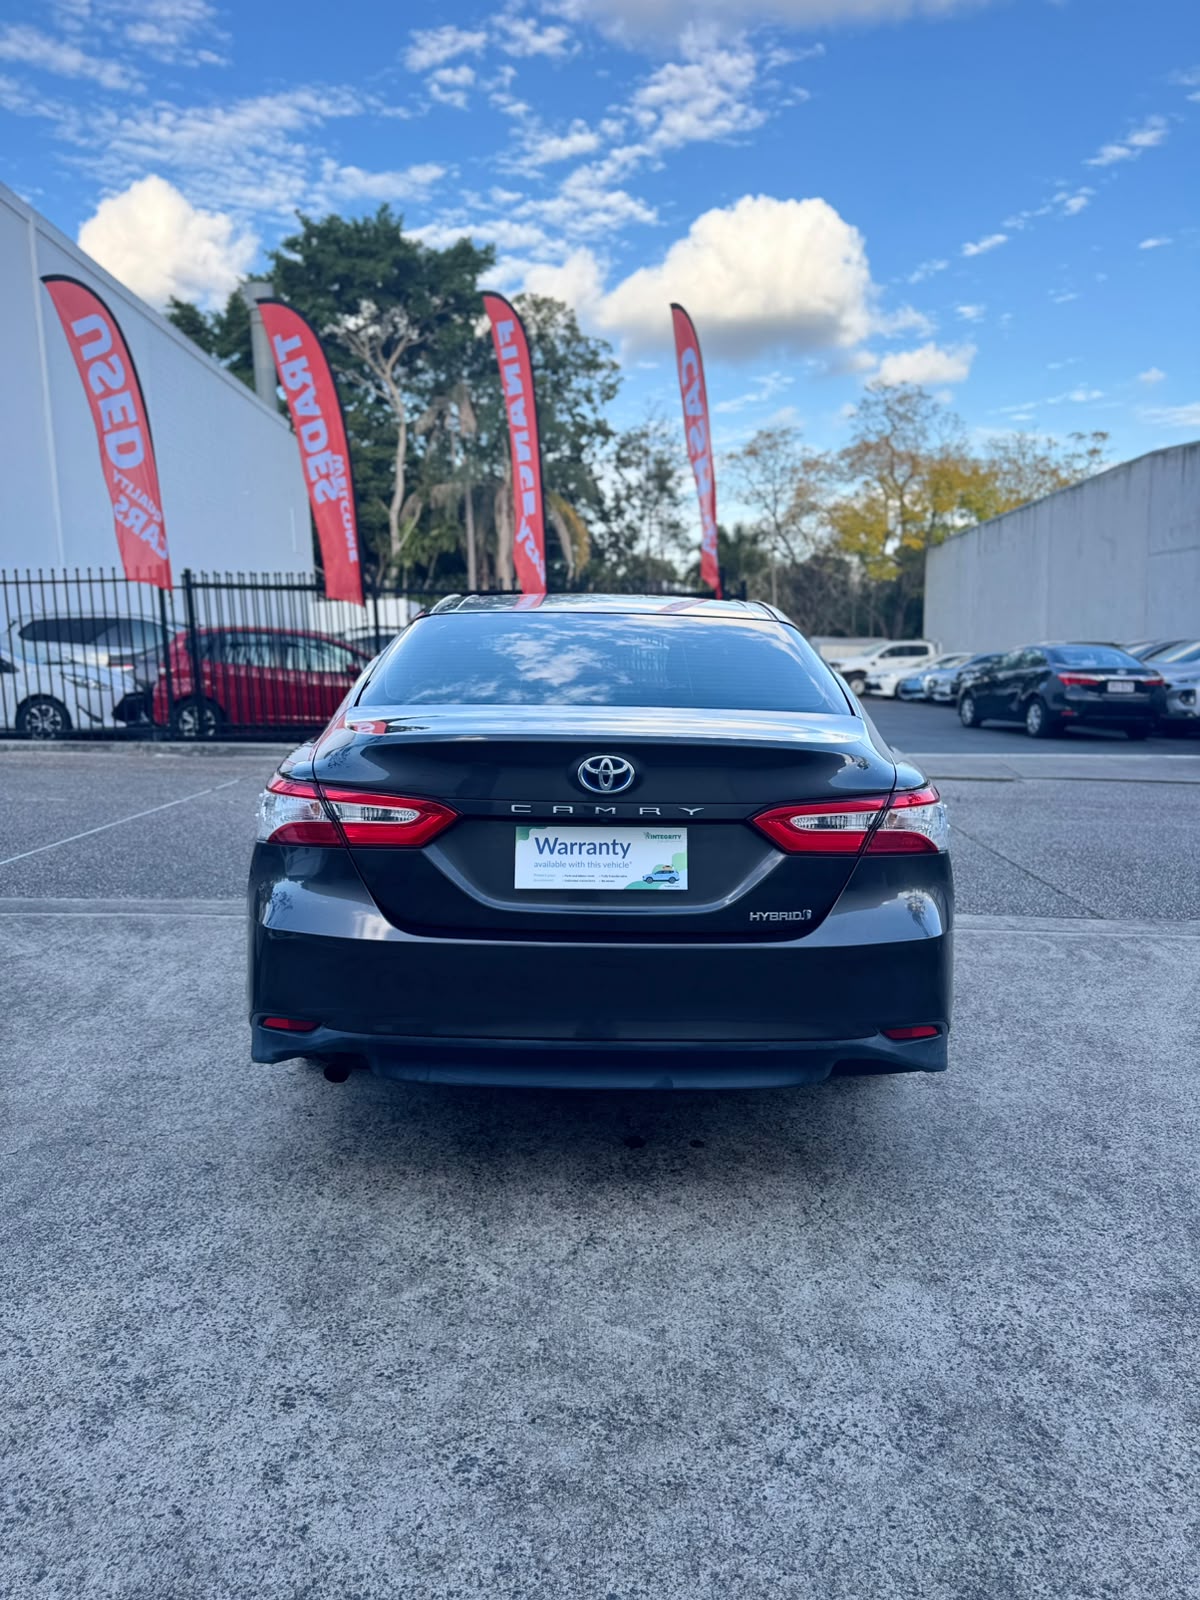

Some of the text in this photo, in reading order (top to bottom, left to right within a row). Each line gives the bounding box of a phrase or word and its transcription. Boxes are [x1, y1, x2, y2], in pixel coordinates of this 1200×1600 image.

[510, 804, 705, 816] CAMRY
[534, 836, 632, 860] Warranty
[587, 861, 602, 869] this
[749, 911, 802, 921] HYBRID
